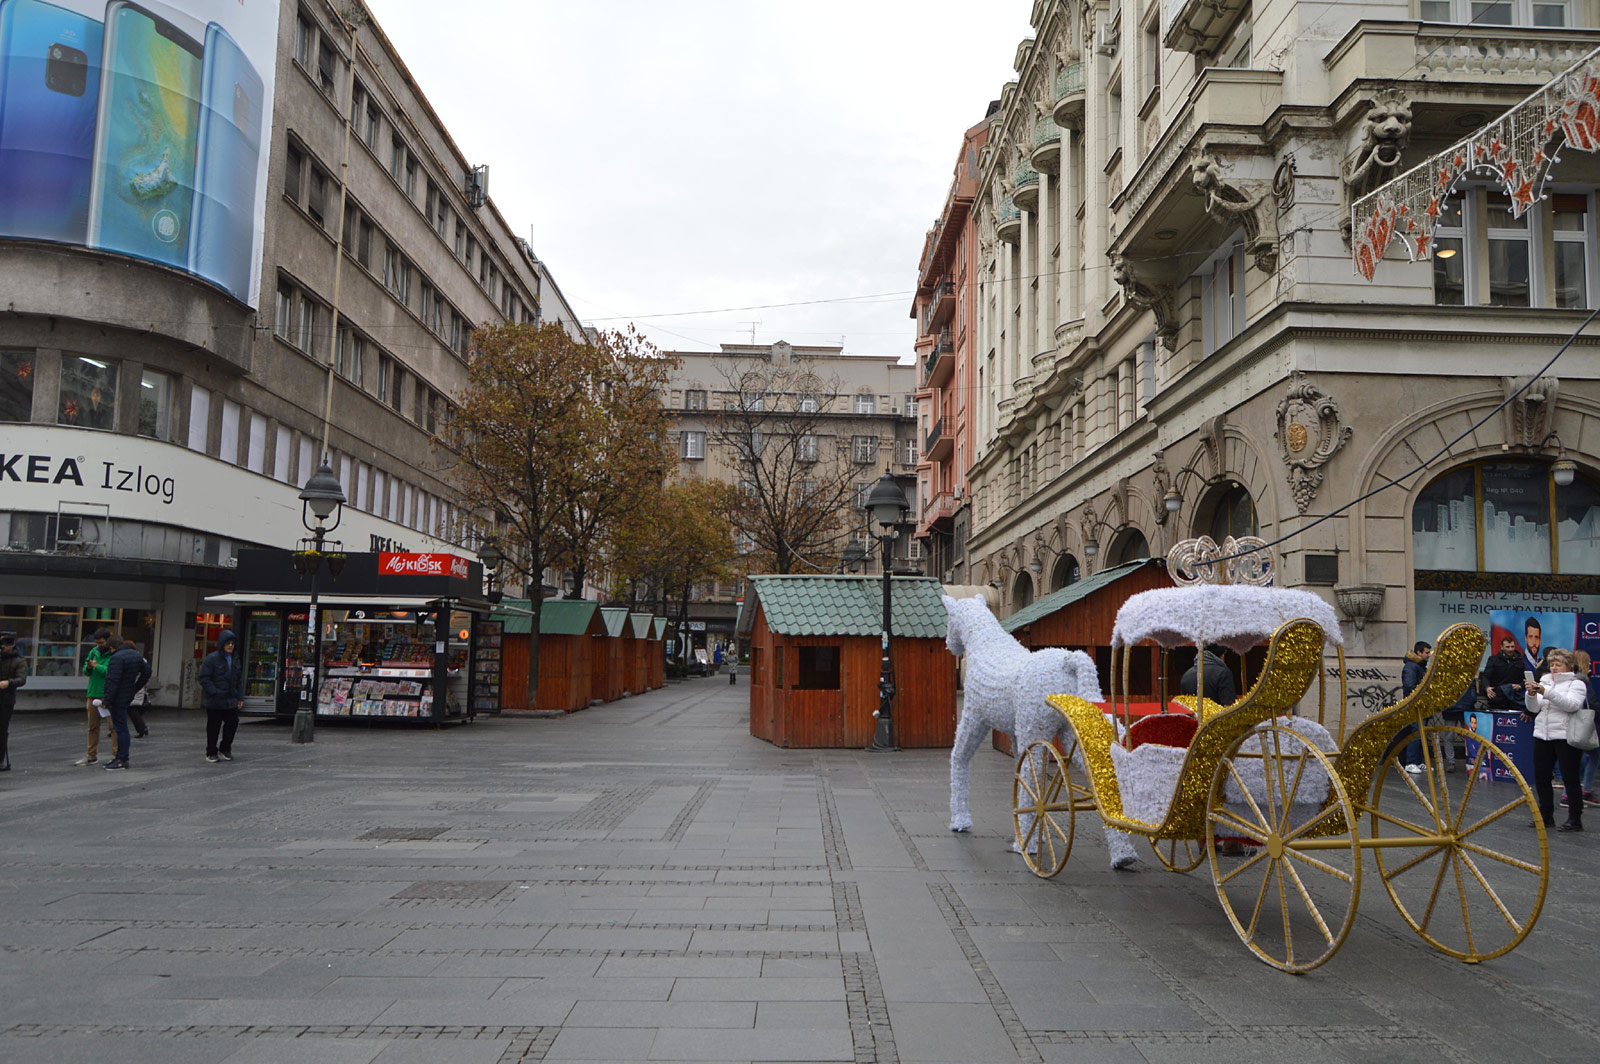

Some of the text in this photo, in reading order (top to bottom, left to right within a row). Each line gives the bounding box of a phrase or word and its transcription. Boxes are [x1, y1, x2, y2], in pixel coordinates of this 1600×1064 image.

[101, 461, 175, 504] Izlog
[1460, 591, 1496, 600] TEAM
[1522, 592, 1579, 602] DECADE
[1440, 603, 1465, 614] THE
